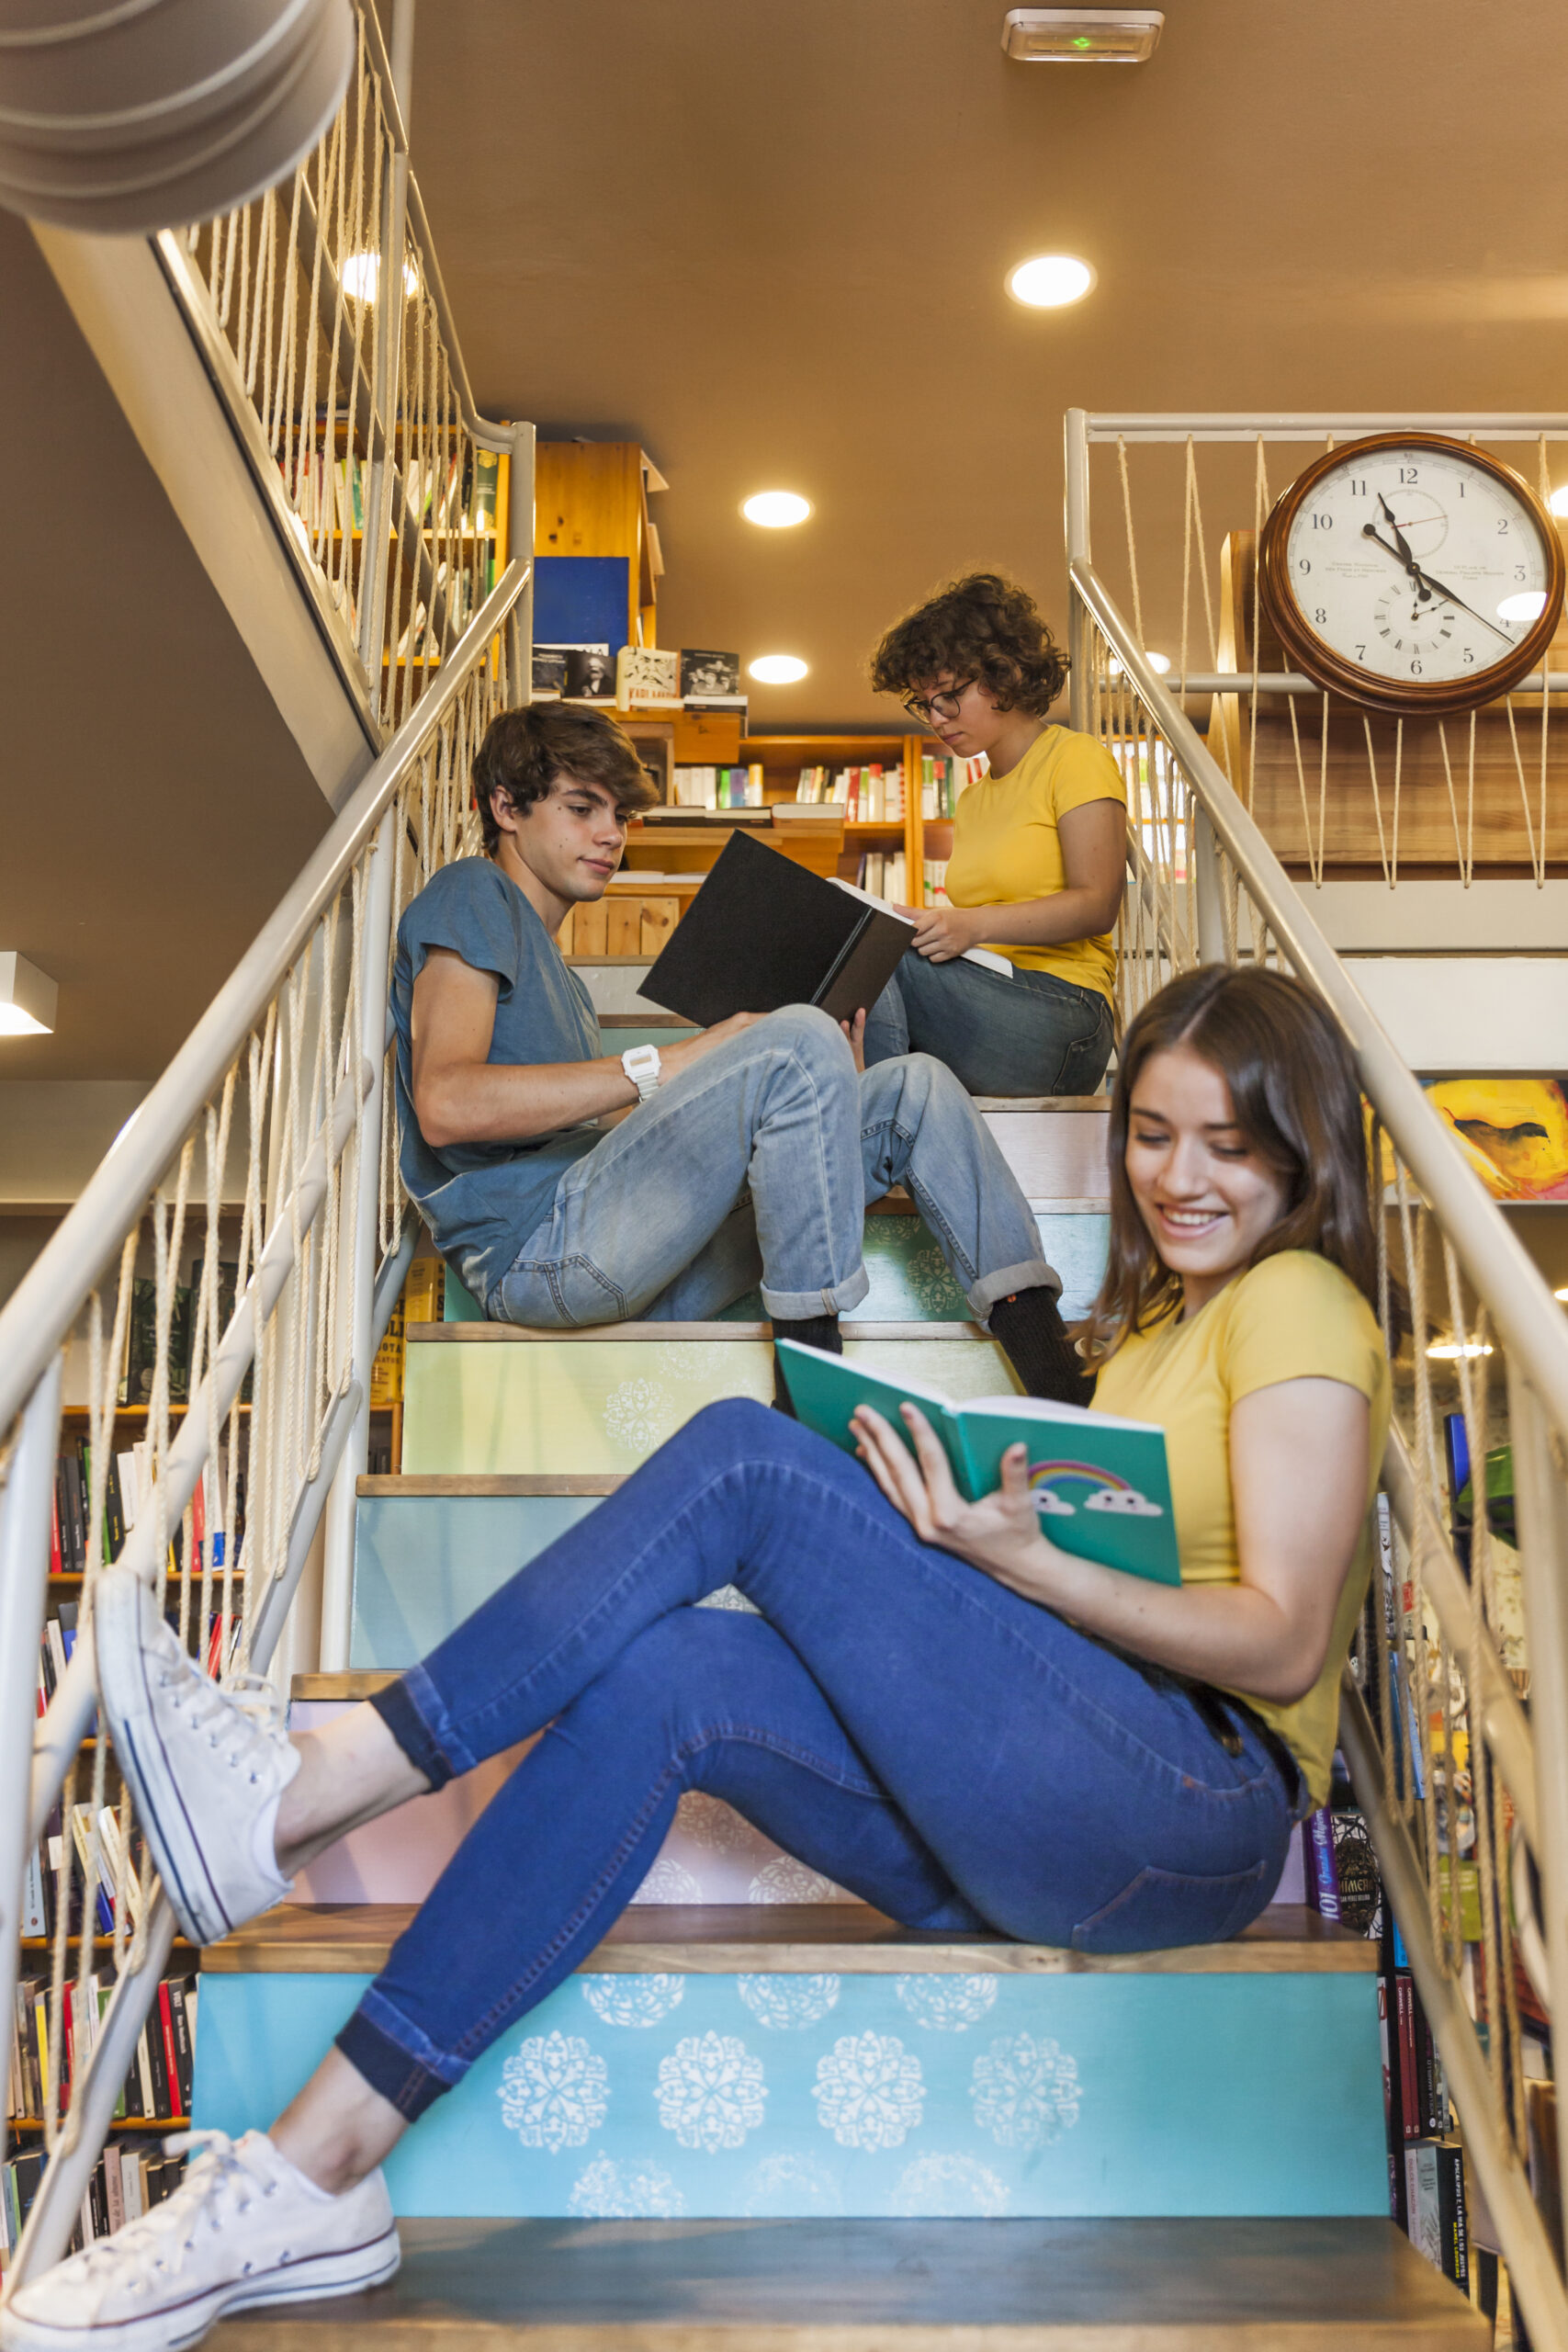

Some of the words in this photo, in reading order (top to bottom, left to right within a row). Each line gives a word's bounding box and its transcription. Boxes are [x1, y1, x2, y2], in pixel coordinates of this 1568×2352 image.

[1397, 468, 1418, 484] 12
[1350, 480, 1368, 496] 11
[1458, 482, 1466, 498] 1
[1312, 514, 1333, 530] 10
[1497, 518, 1509, 535] 2
[1299, 559, 1311, 575] 9
[1514, 565, 1527, 582] 3
[1314, 607, 1327, 624] 8
[1355, 645, 1367, 661] 7
[1463, 647, 1474, 663] 5
[1410, 660, 1423, 675] 6
[1318, 1892, 1339, 1919] 101
